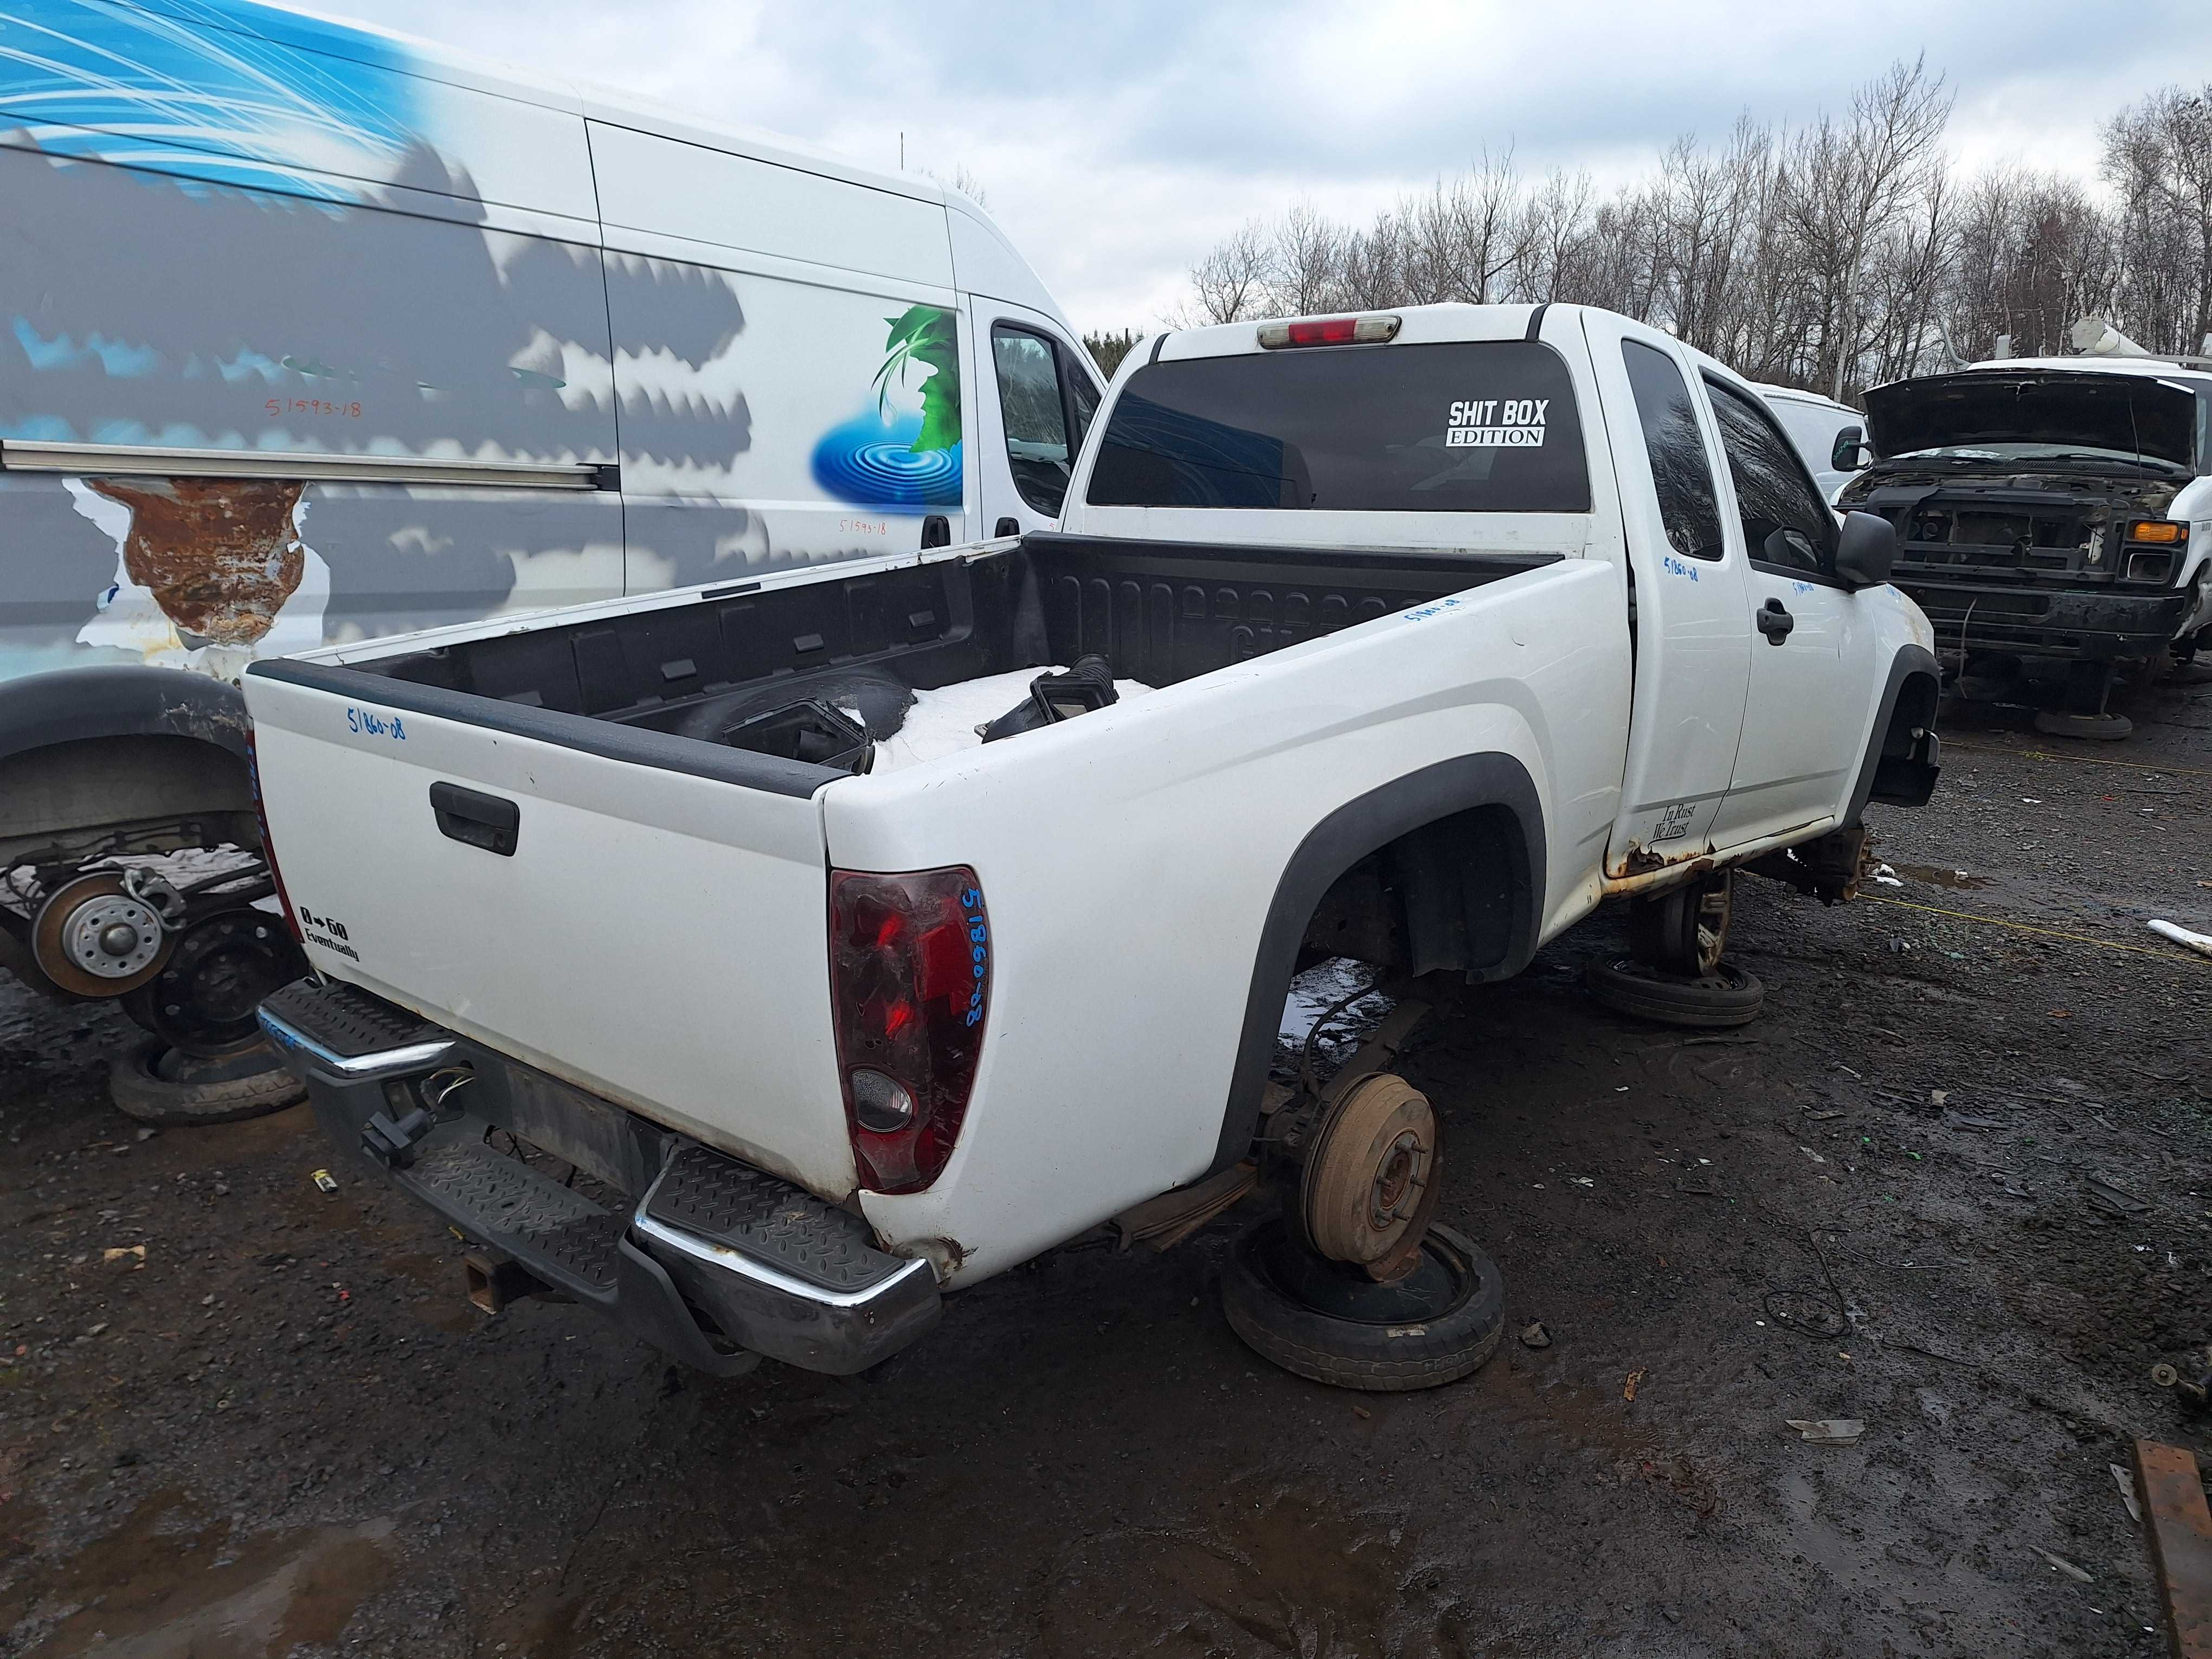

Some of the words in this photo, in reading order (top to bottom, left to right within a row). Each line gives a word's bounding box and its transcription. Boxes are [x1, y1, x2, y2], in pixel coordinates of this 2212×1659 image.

[265, 398, 361, 416] 51593-18
[1449, 400, 1497, 426] SHIT
[1502, 400, 1549, 425] BOX
[1450, 429, 1541, 444] EDITION
[839, 519, 886, 535] 51593-18
[1664, 555, 1698, 582] 51860-08
[1404, 599, 1460, 621] 51860-08
[347, 707, 406, 740] 51860-08
[1662, 806, 1674, 821] In
[1674, 802, 1696, 820] Rust
[1652, 822, 1666, 839] We
[1665, 819, 1690, 837] Trust
[304, 927, 360, 962] Eventually
[962, 888, 986, 1027] 51860-08
